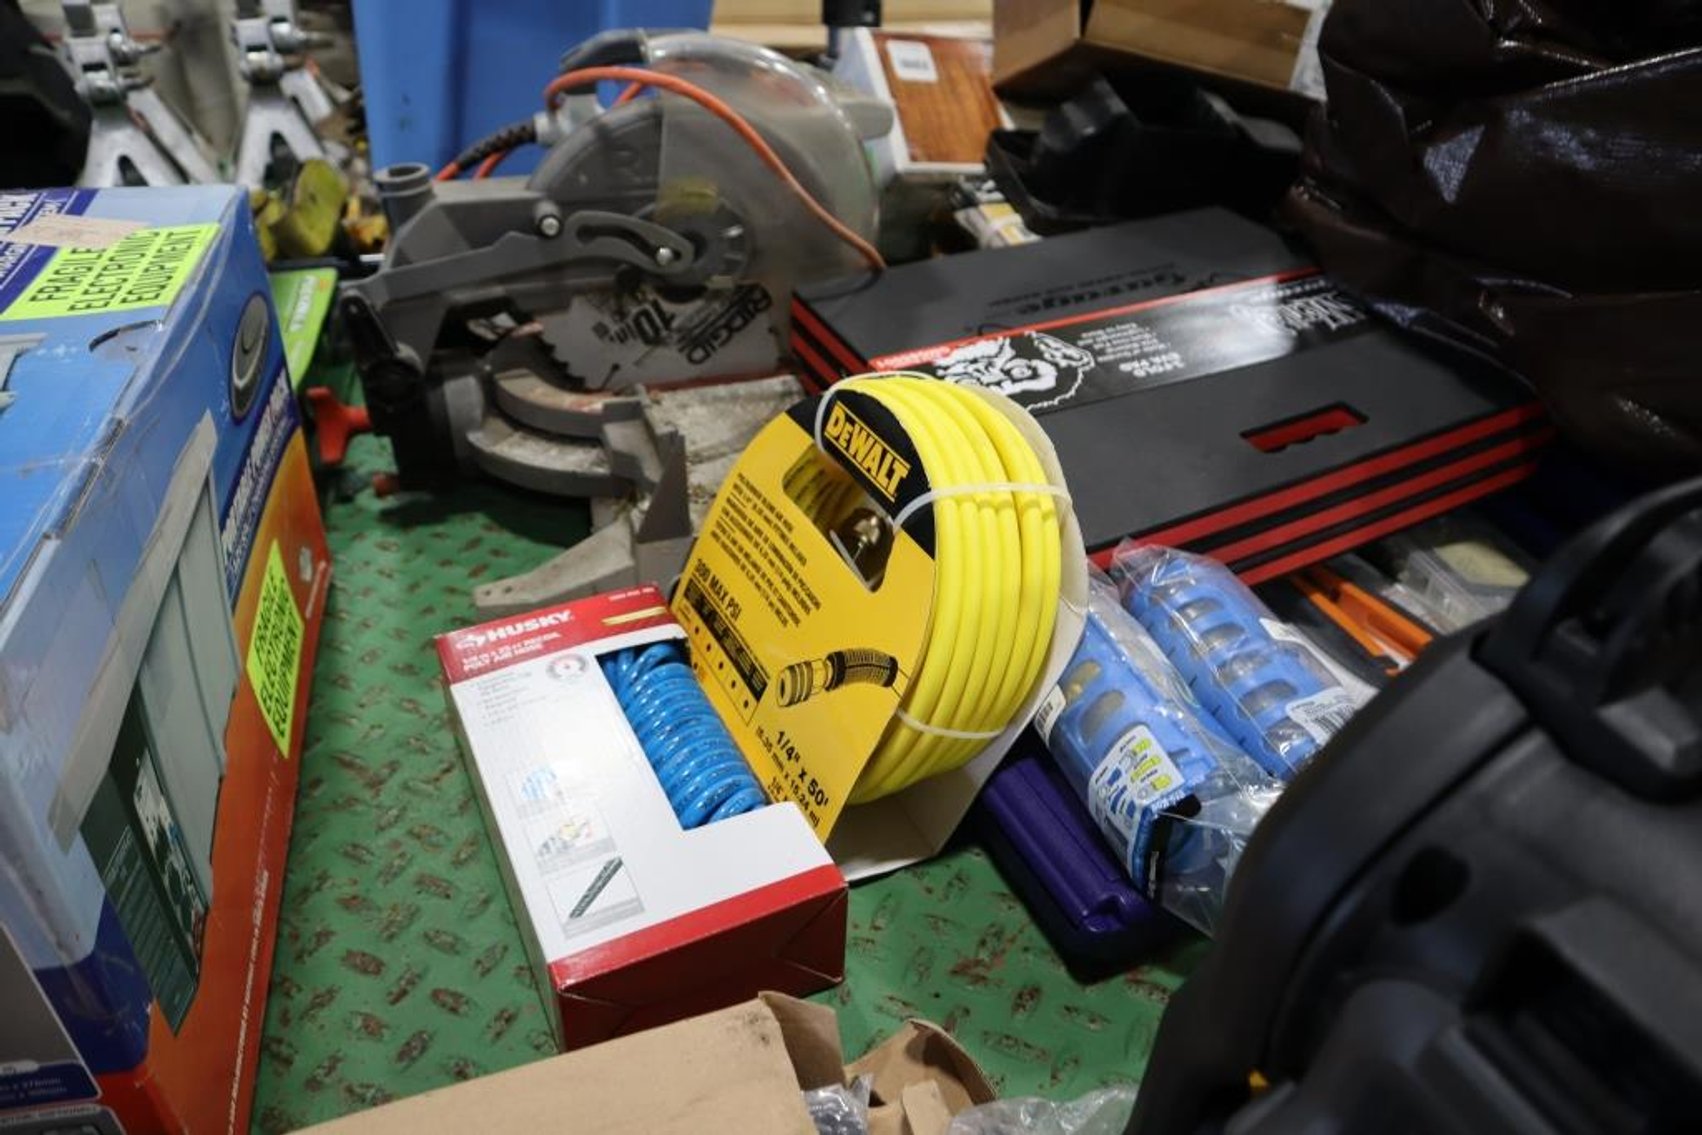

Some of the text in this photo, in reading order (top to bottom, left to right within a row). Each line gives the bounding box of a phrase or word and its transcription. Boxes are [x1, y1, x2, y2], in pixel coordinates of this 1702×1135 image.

[29, 247, 107, 303] FRAGILE
[67, 231, 160, 311] ELECTRONIC
[119, 229, 202, 305] EQUIPMENT
[686, 284, 773, 366] RIDGID
[487, 610, 569, 641] HUSKY
[709, 574, 729, 604] MAX
[725, 596, 742, 622] PSI
[777, 730, 830, 806] 1/4" x 50'
